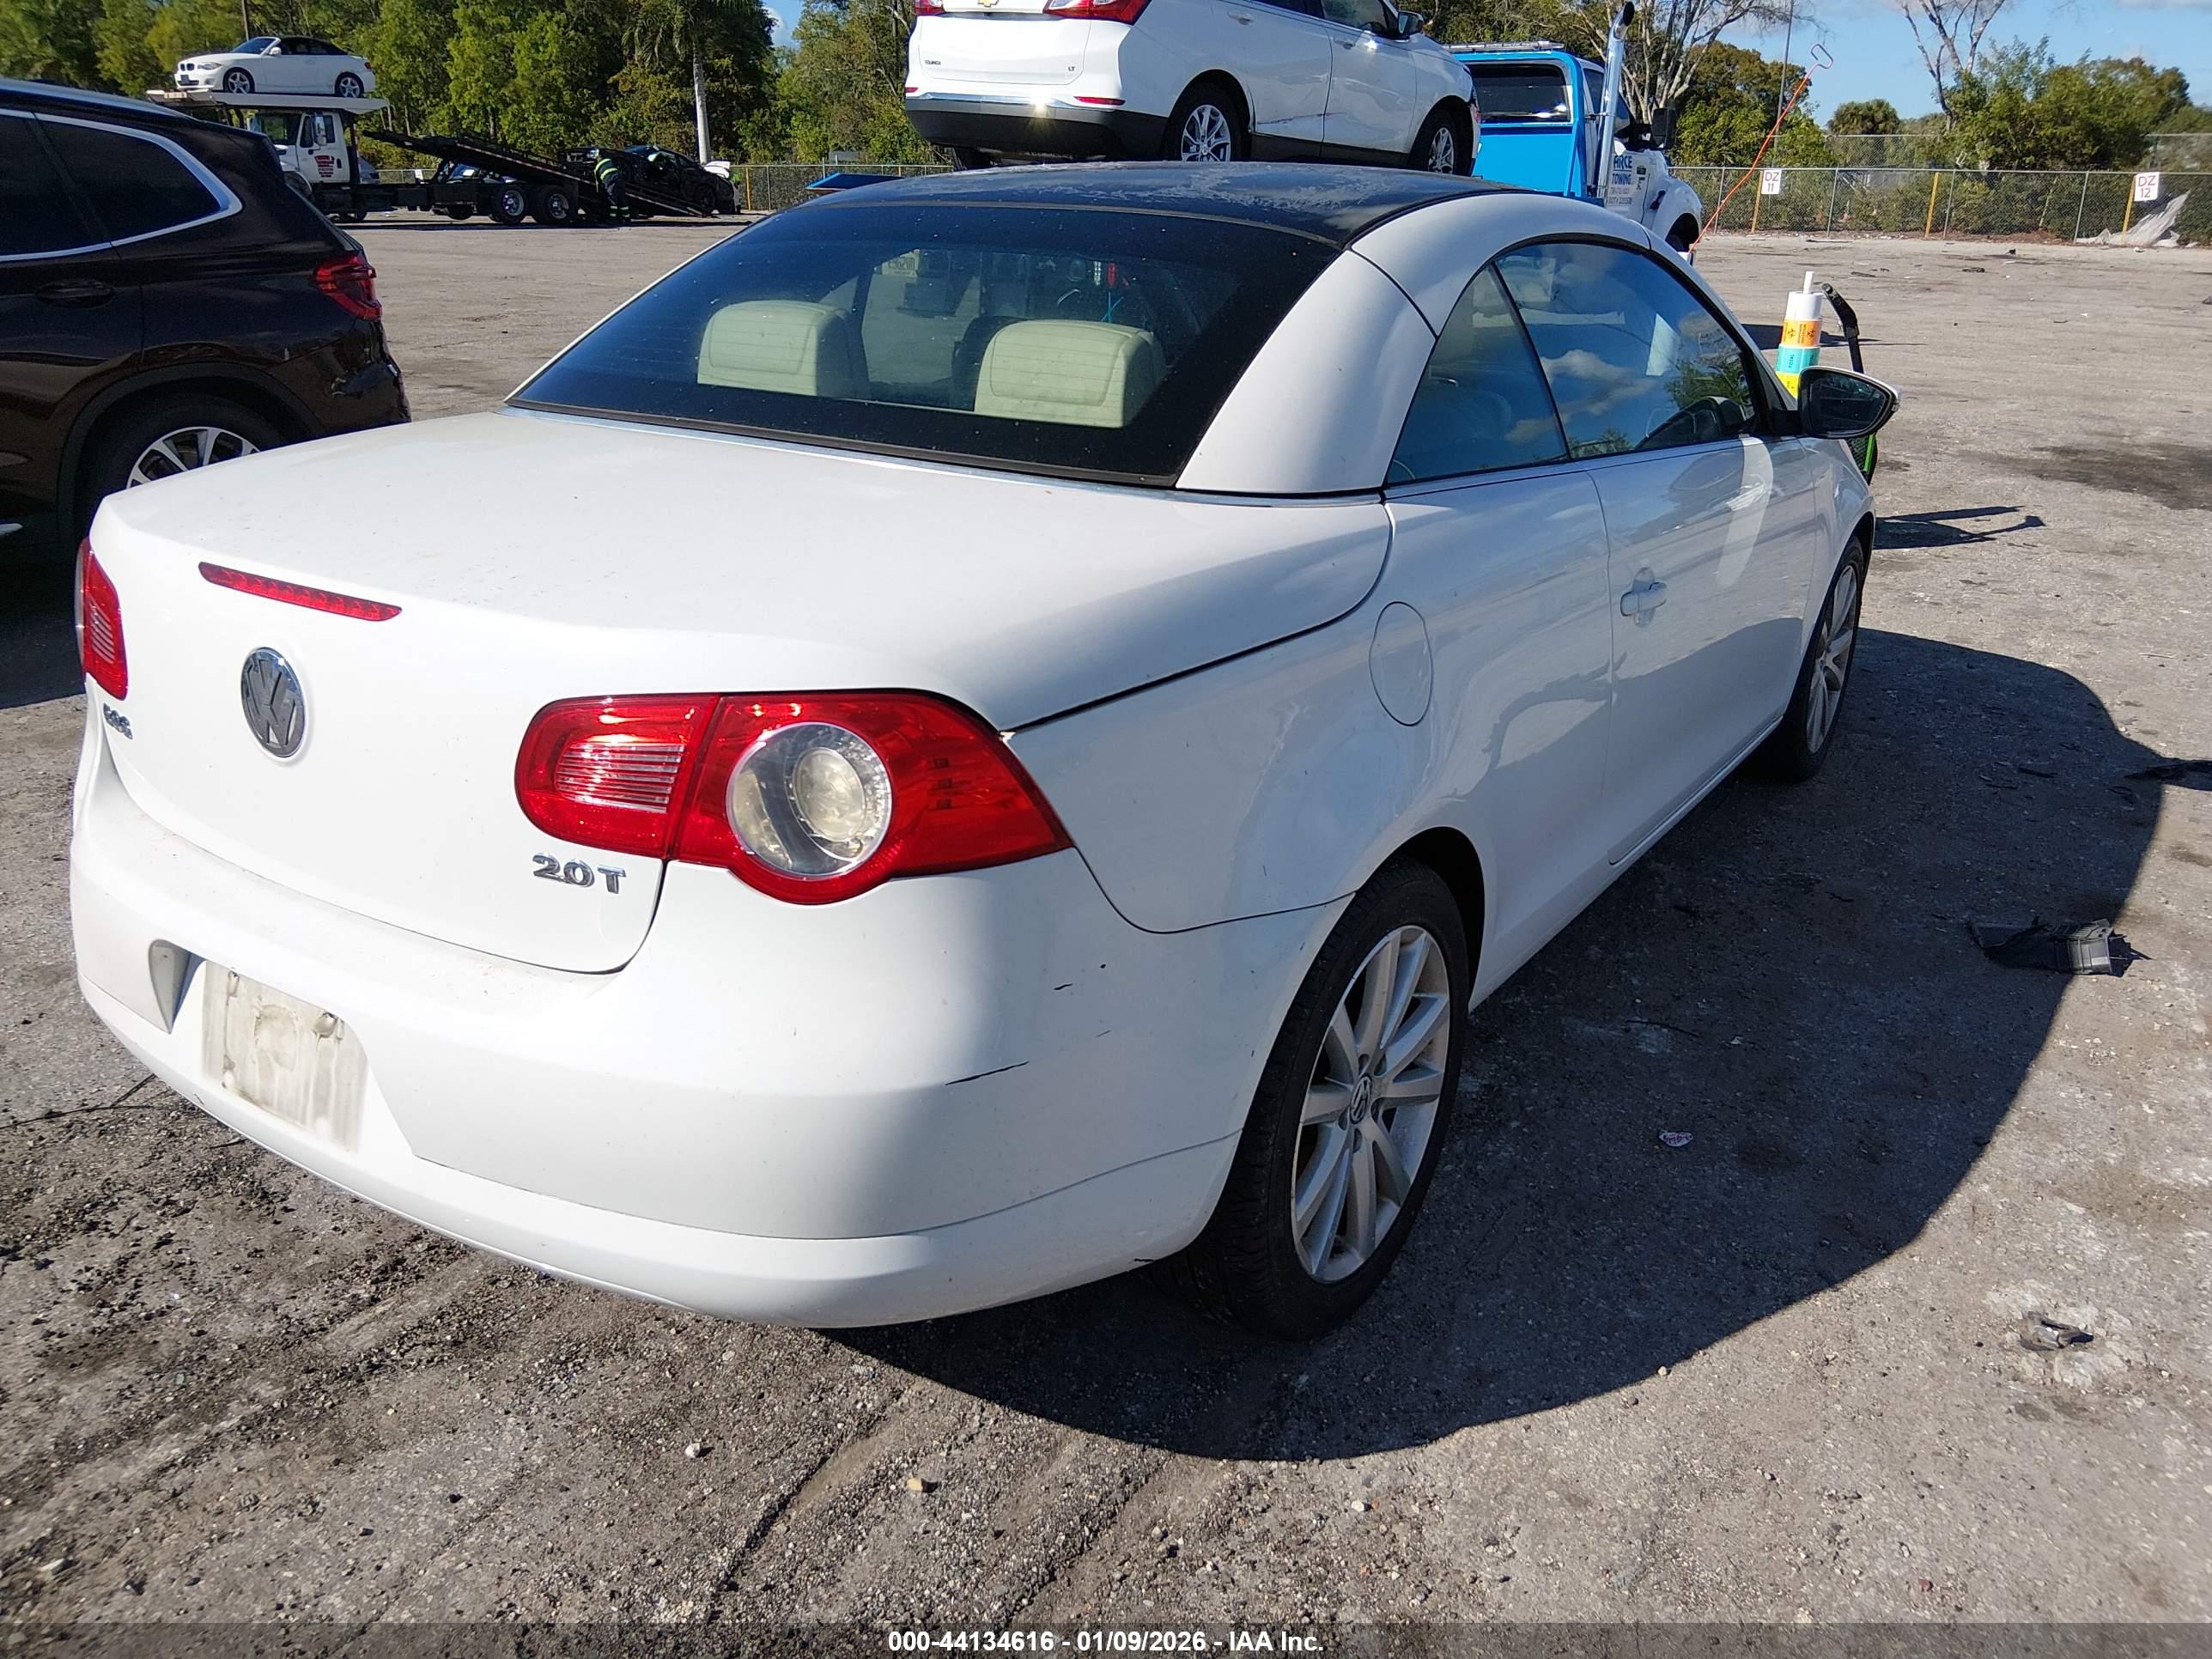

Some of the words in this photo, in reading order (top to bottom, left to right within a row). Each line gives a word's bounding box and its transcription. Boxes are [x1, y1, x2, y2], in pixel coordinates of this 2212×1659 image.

[1613, 155, 1633, 169] ARCE
[1612, 173, 1632, 185] TOWING
[1765, 172, 1779, 181] DZ
[2138, 175, 2156, 186] DZ
[1767, 183, 1774, 192] 11
[2140, 188, 2151, 199] 12
